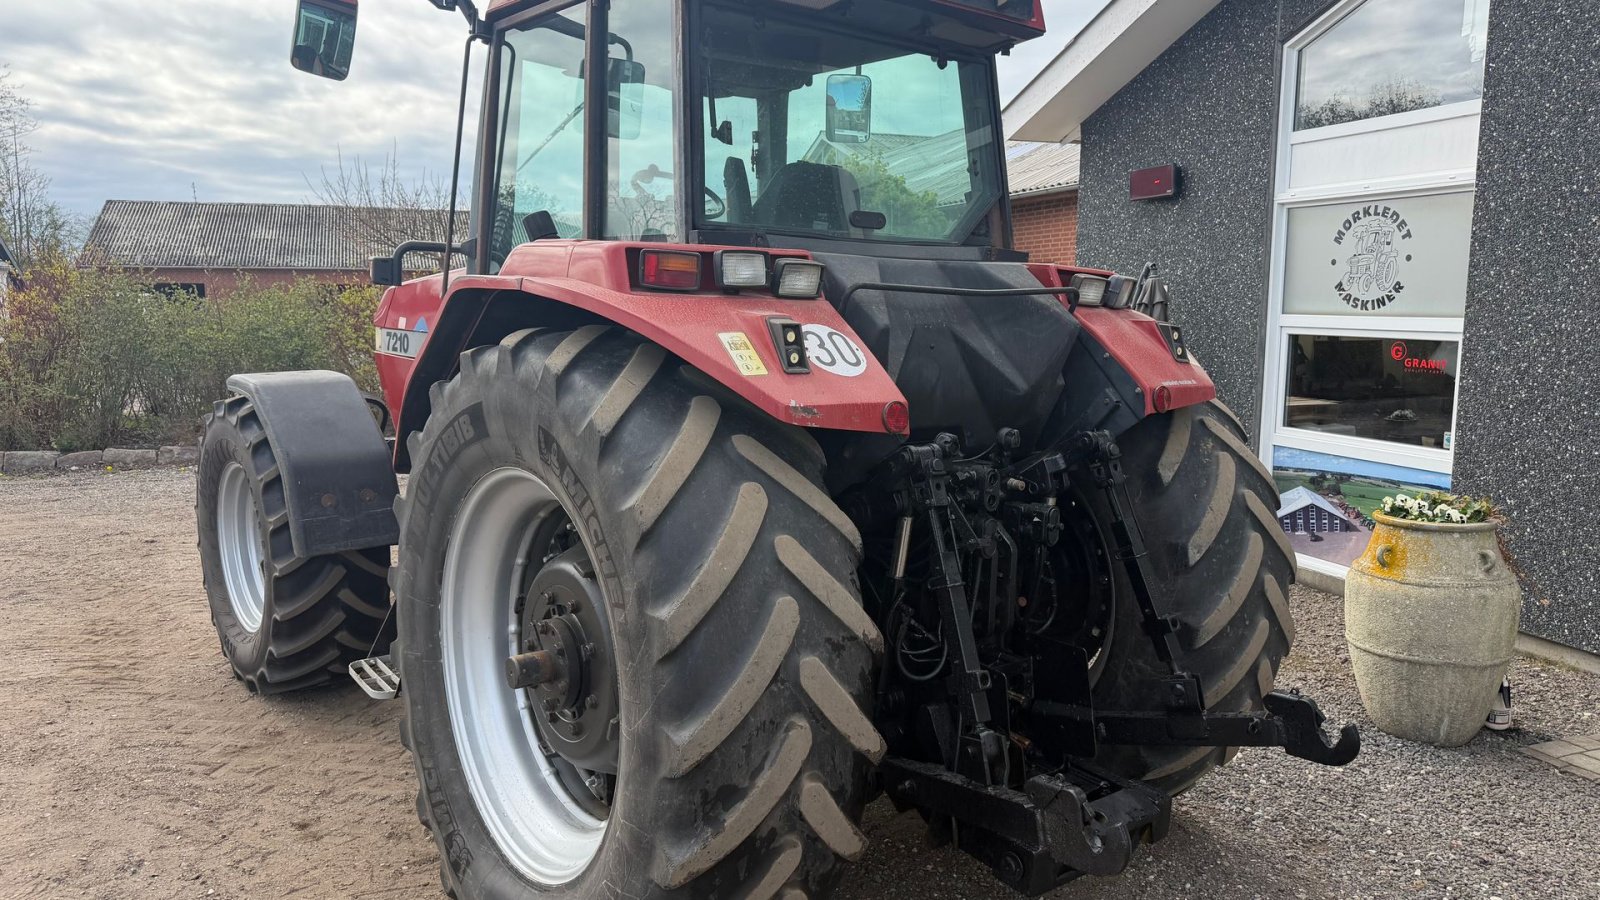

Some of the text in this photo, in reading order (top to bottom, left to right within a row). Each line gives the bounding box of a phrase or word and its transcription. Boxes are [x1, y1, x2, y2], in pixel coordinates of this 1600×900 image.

[1333, 205, 1412, 245] MØRKLEDET
[1334, 280, 1404, 311] MASKINER
[386, 331, 409, 353] 7210
[803, 330, 861, 367] 30
[1404, 358, 1447, 369] GRANIT
